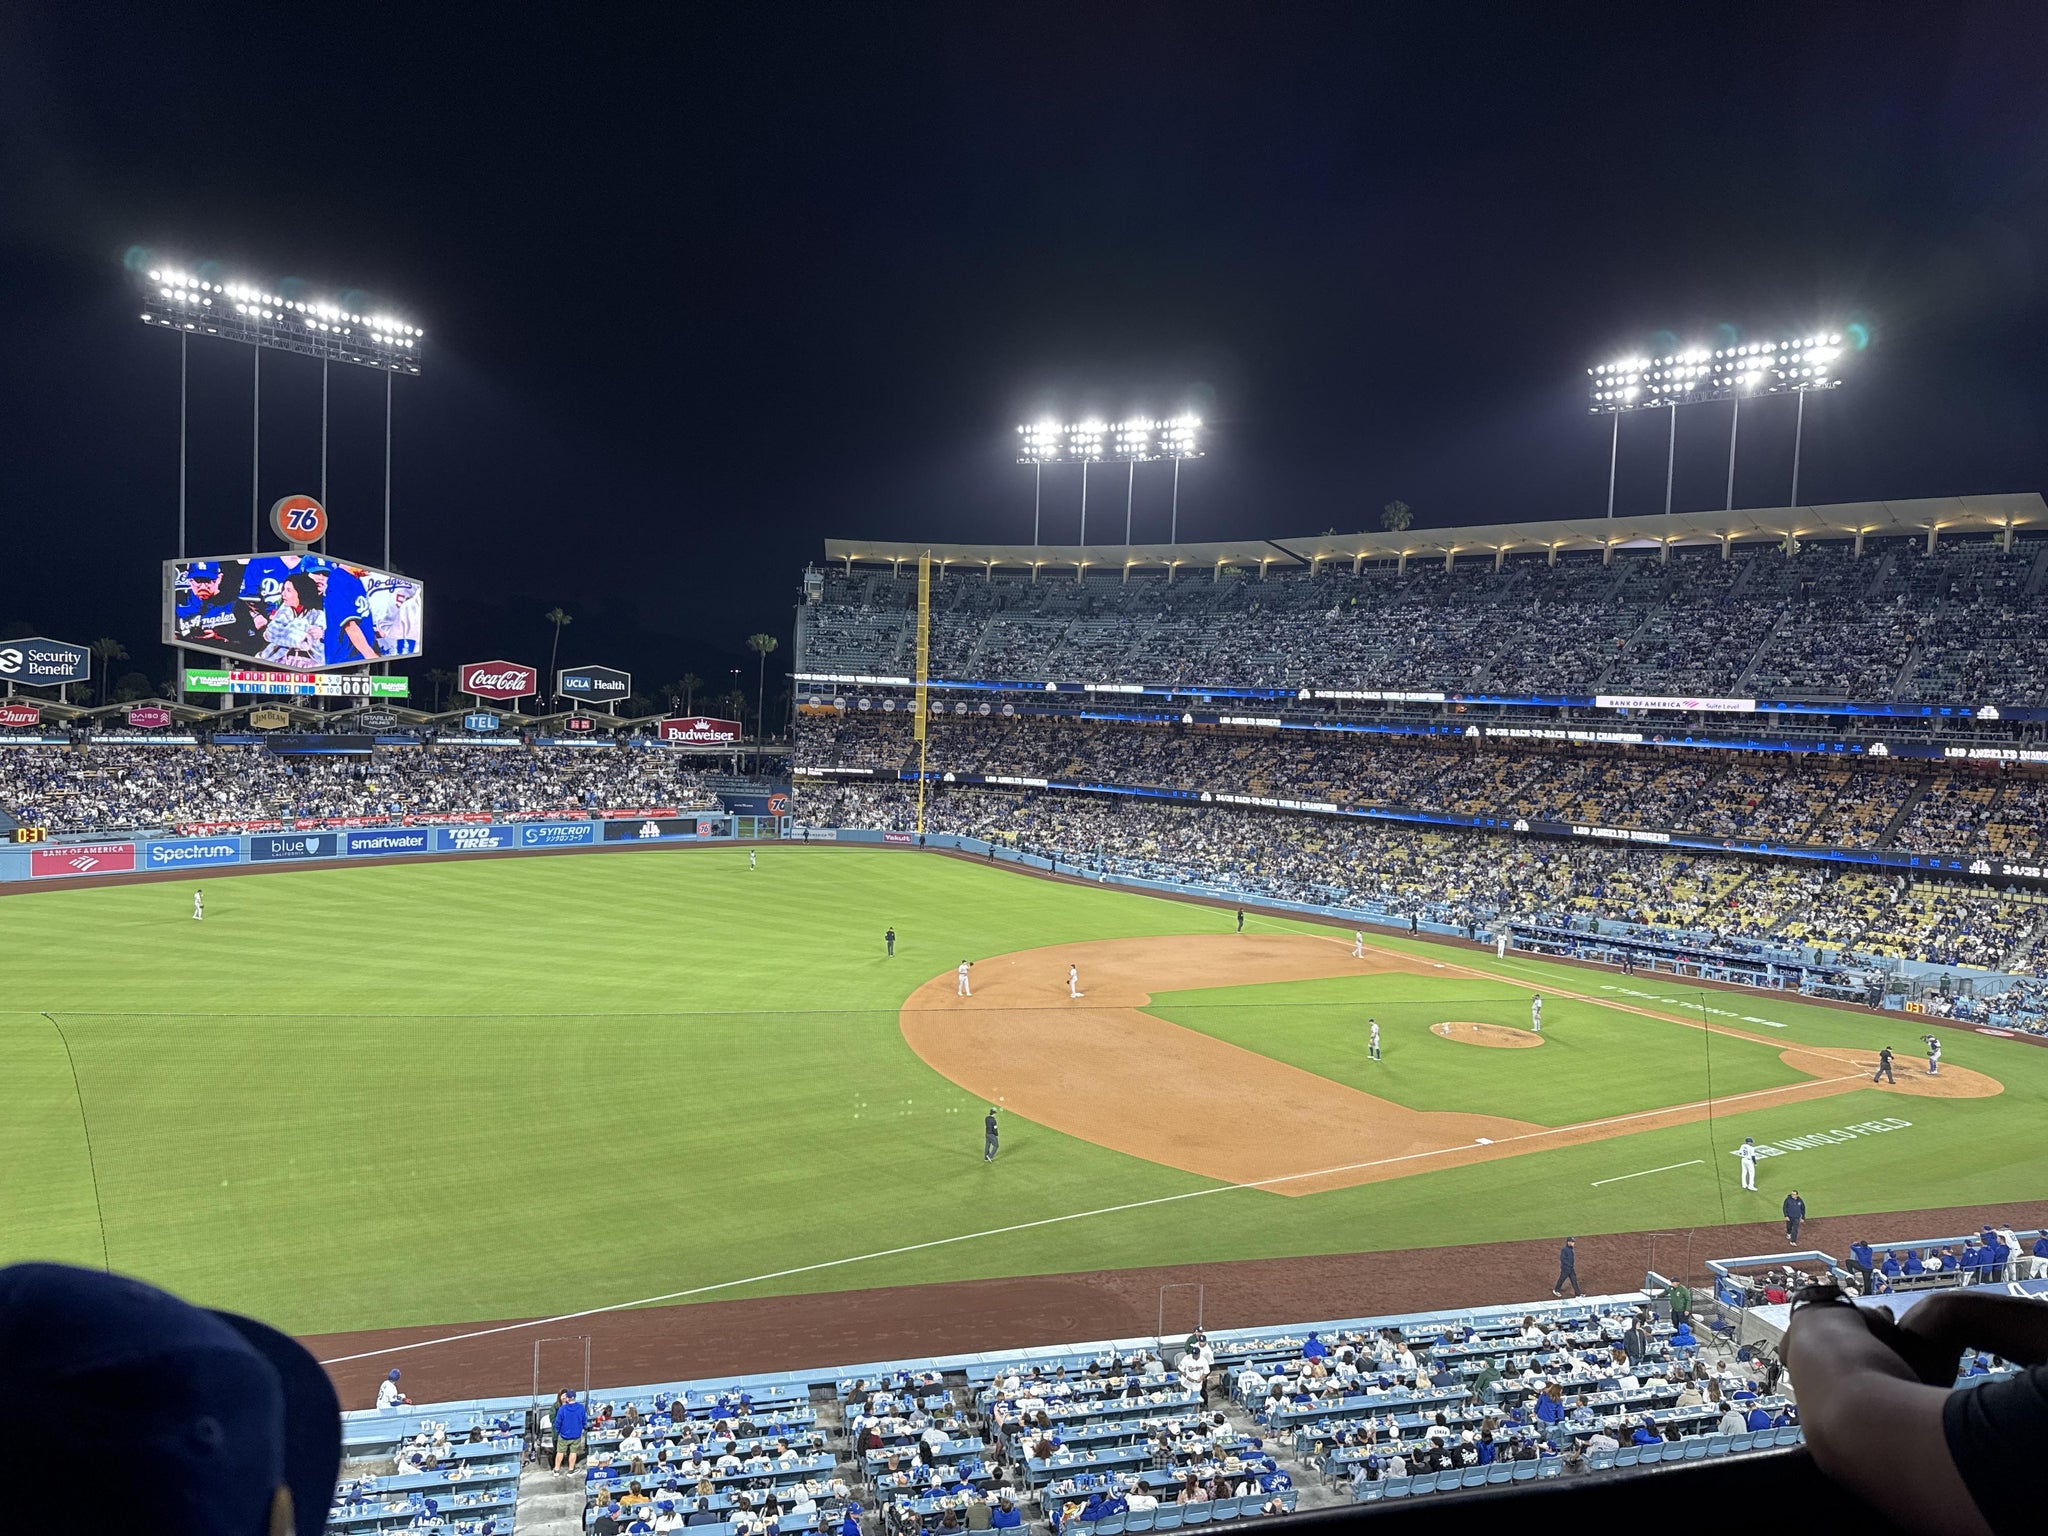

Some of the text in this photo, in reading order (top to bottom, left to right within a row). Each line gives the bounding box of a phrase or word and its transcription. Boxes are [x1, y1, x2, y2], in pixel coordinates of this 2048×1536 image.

[287, 508, 318, 532] 76
[28, 650, 81, 665] Security
[29, 662, 74, 676] Benefit
[469, 670, 529, 690] Coca-Cola
[566, 680, 625, 690] UCLA Health
[0, 710, 38, 722] Churu
[254, 712, 286, 724] JIM BEAM
[470, 716, 494, 728] TEL
[668, 728, 734, 740] Budweiser
[18, 828, 46, 842] 0:37
[449, 828, 490, 839] TOYO
[540, 826, 590, 835] SYNCRON
[700, 824, 709, 834] 76
[272, 840, 304, 852] blue
[352, 836, 424, 850] smartwater
[454, 836, 500, 849] TIRES
[42, 848, 68, 857] BANK
[80, 846, 124, 854] AMERICA
[152, 844, 228, 864] Spectrum
[1772, 1117, 1913, 1151] UNIQLO FIELD
